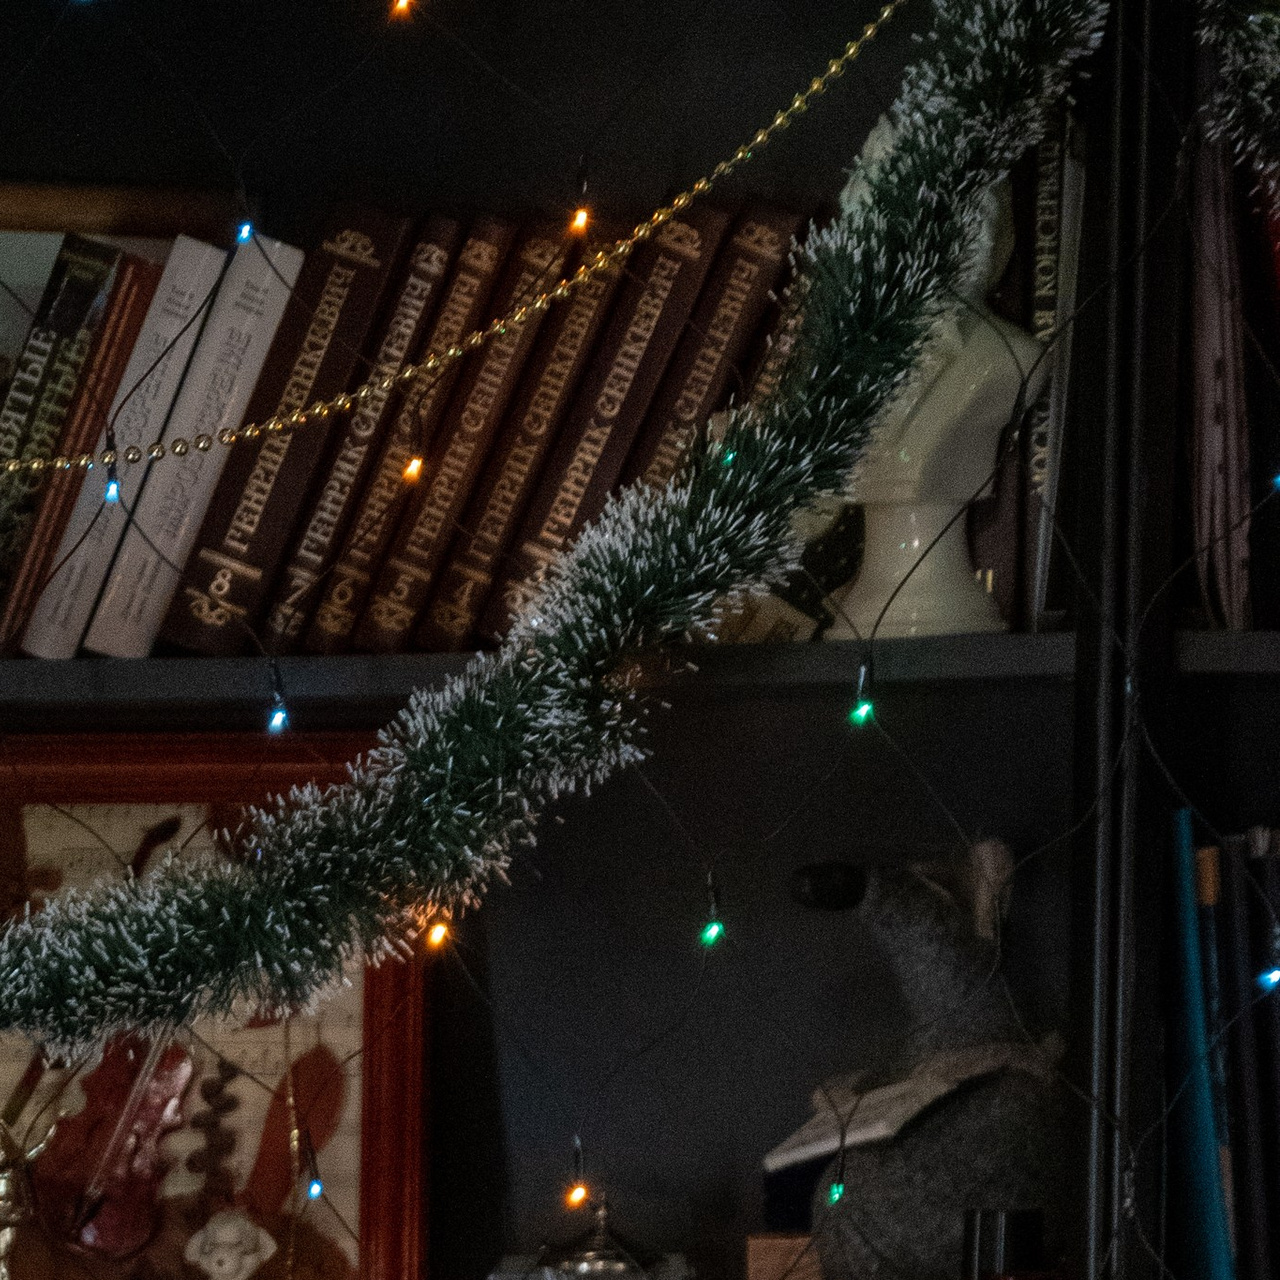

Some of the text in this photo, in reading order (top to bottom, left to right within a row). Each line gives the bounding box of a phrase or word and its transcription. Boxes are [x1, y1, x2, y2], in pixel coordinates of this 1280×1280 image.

[539, 418, 613, 546] ГЕНРИК
[597, 254, 682, 419] СЕНКЕВИЧ
[675, 259, 759, 421] СЕНКЕВИЧ
[225, 430, 292, 552] ГЕНРИК
[469, 436, 538, 561] ГЕНРИК
[523, 279, 606, 436] СЕНКЕВИЧ
[298, 436, 368, 562] ГЕНРИК
[406, 432, 476, 557] ГЕНРИК
